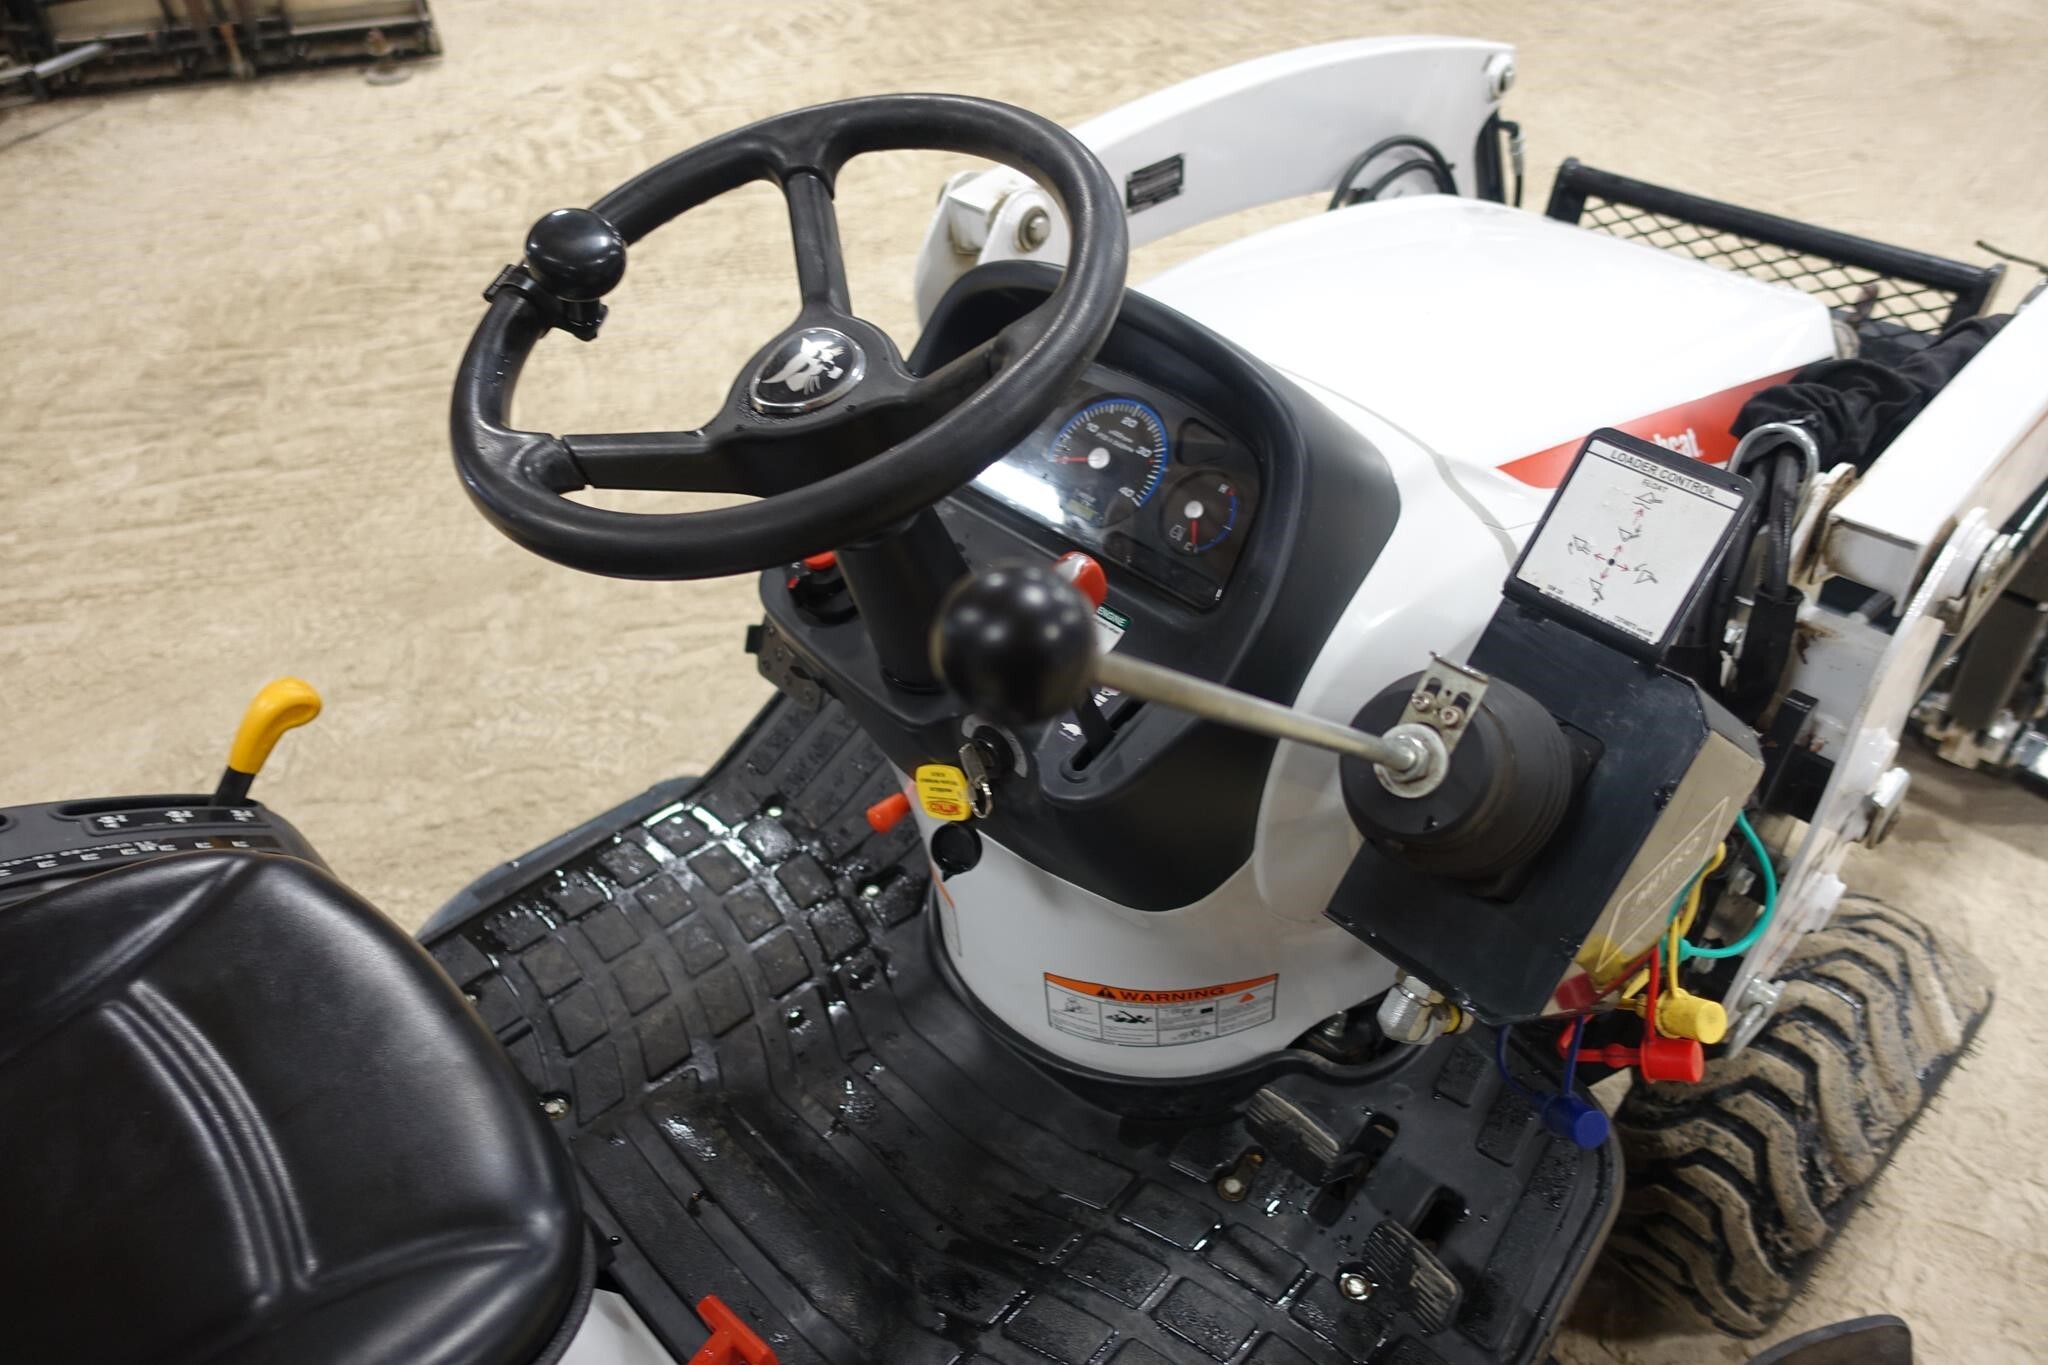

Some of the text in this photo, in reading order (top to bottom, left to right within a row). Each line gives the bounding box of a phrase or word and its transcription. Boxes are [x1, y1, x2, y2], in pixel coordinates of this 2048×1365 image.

[1610, 449, 1715, 498] LOADER CONTROL
[1641, 478, 1669, 492] FLOAT
[1095, 605, 1128, 627] ENGINE
[1119, 986, 1225, 1003] WARNING
